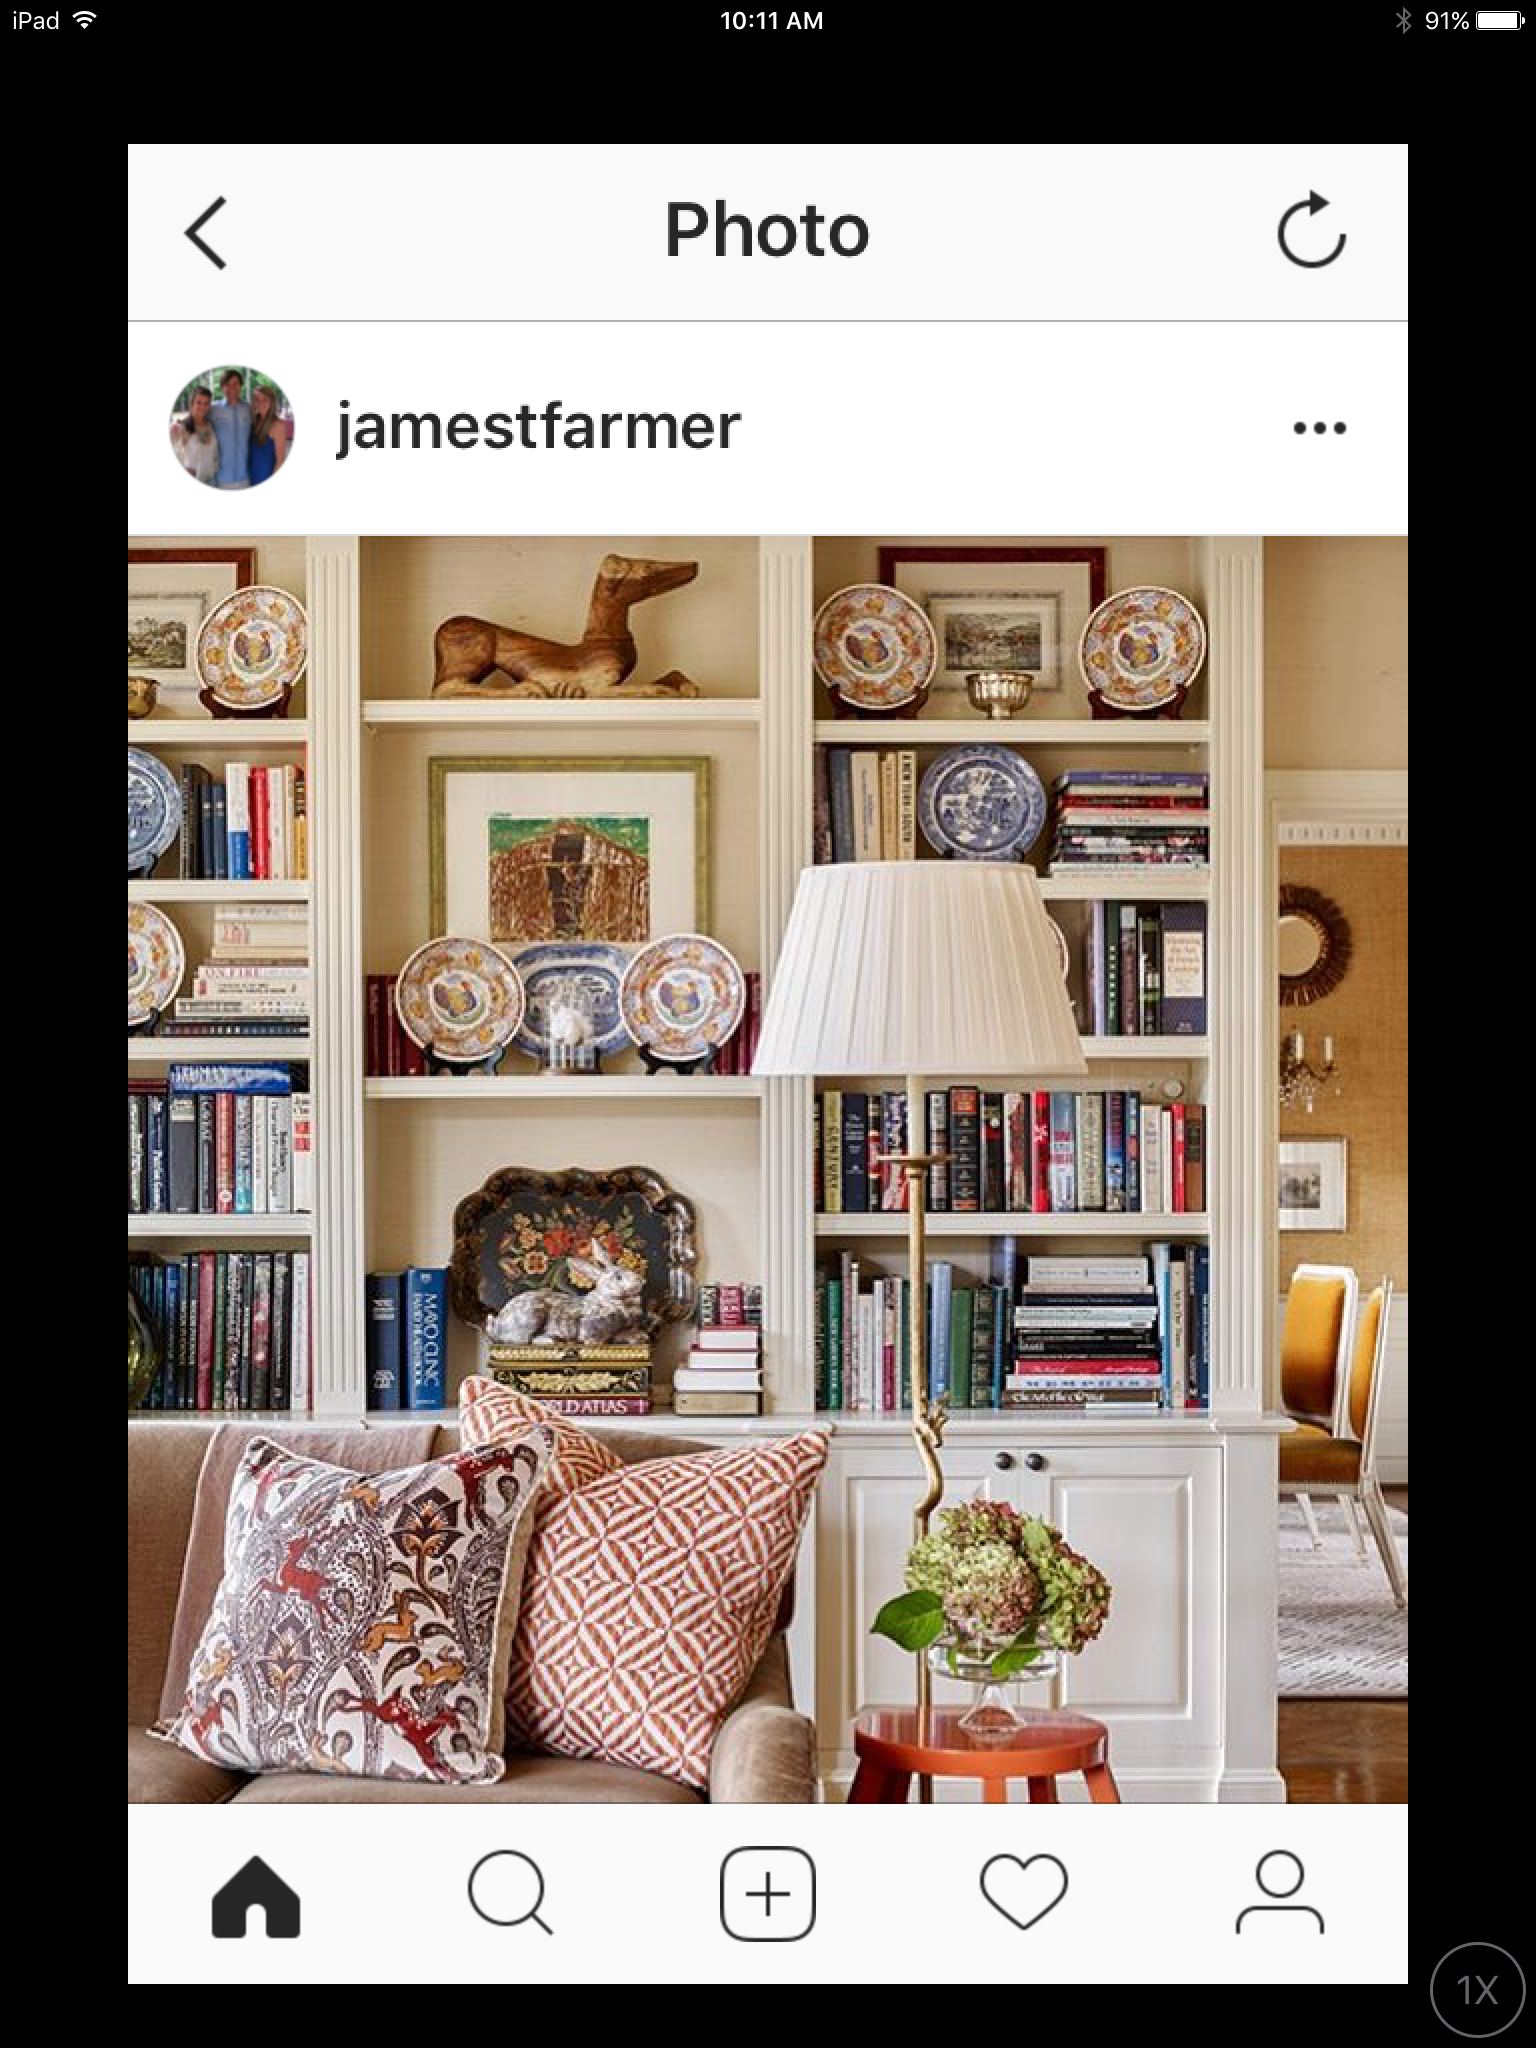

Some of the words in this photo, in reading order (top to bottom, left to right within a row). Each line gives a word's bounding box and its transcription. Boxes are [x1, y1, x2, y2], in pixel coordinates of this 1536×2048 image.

[13, 10, 59, 30] iPad
[720, 11, 778, 31] 10:11
[786, 11, 823, 31] AM
[1426, 11, 1470, 31] 91%
[667, 199, 869, 257] Photo
[335, 399, 743, 461] jamestfarmer
[581, 1399, 628, 1414] ATLAS
[1457, 1975, 1499, 2005] 1X
